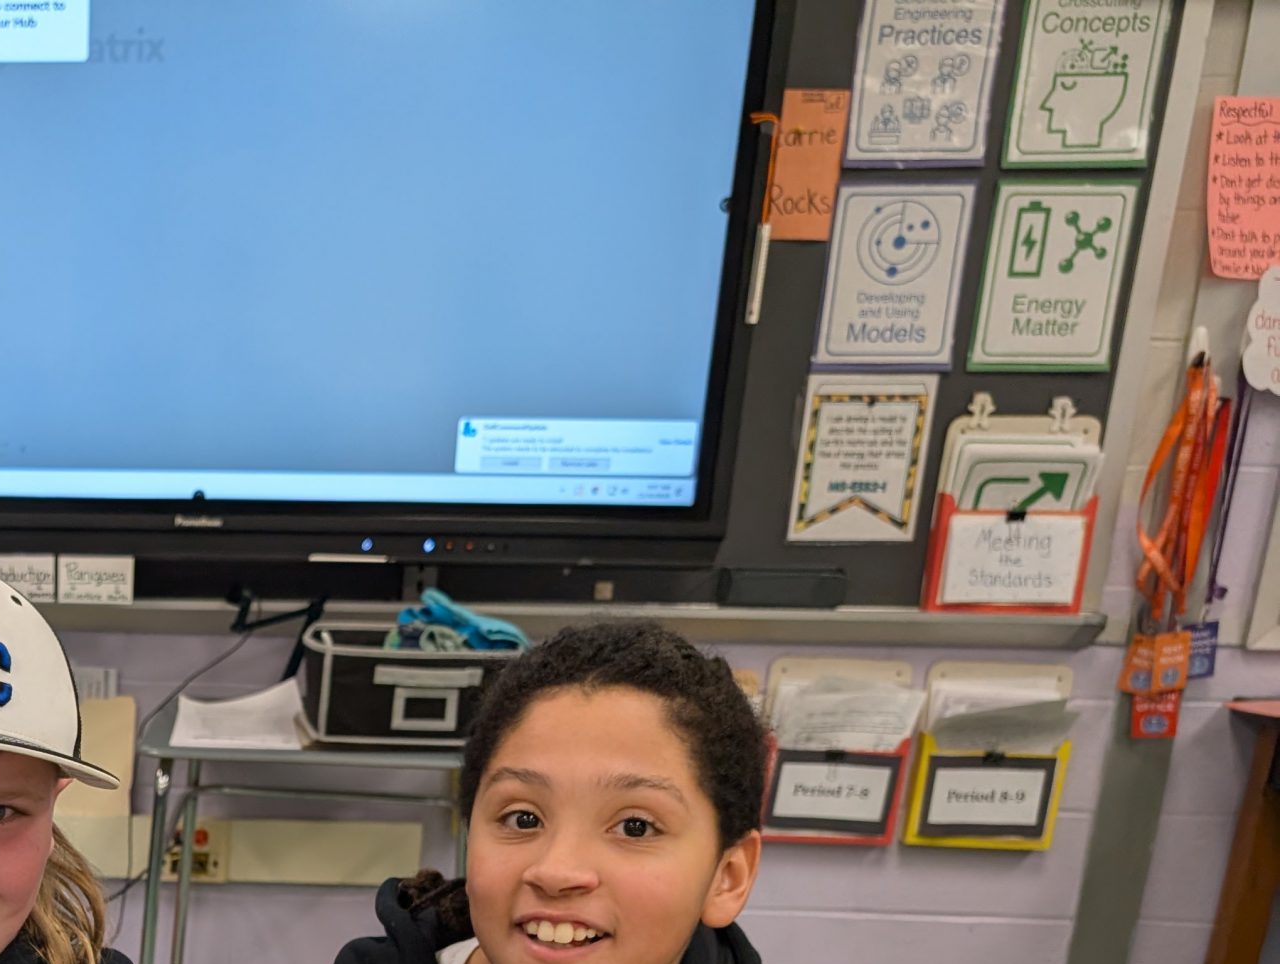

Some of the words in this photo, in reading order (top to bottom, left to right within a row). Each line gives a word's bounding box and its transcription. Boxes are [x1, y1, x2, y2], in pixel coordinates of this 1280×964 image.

[6, 1, 50, 12] connect
[53, 1, 66, 11] to
[894, 8, 973, 22] Engineering
[14, 17, 37, 28] Hub
[1042, 11, 1151, 38] Concepts
[878, 24, 983, 45] Practices
[89, 27, 166, 64] atrix
[1220, 102, 1273, 122] Respectful
[1226, 130, 1252, 145] Look
[770, 185, 832, 216] Rocks
[857, 292, 926, 306] Developing
[1012, 294, 1087, 319] Energy
[859, 307, 882, 319] and
[885, 307, 920, 321] Using
[846, 323, 927, 343] Models
[1012, 317, 1080, 337] Matter
[975, 529, 1052, 559] Meeting
[999, 554, 1021, 565] the
[968, 568, 1052, 588] Standards
[793, 783, 843, 799] Period
[947, 789, 995, 803] Period
